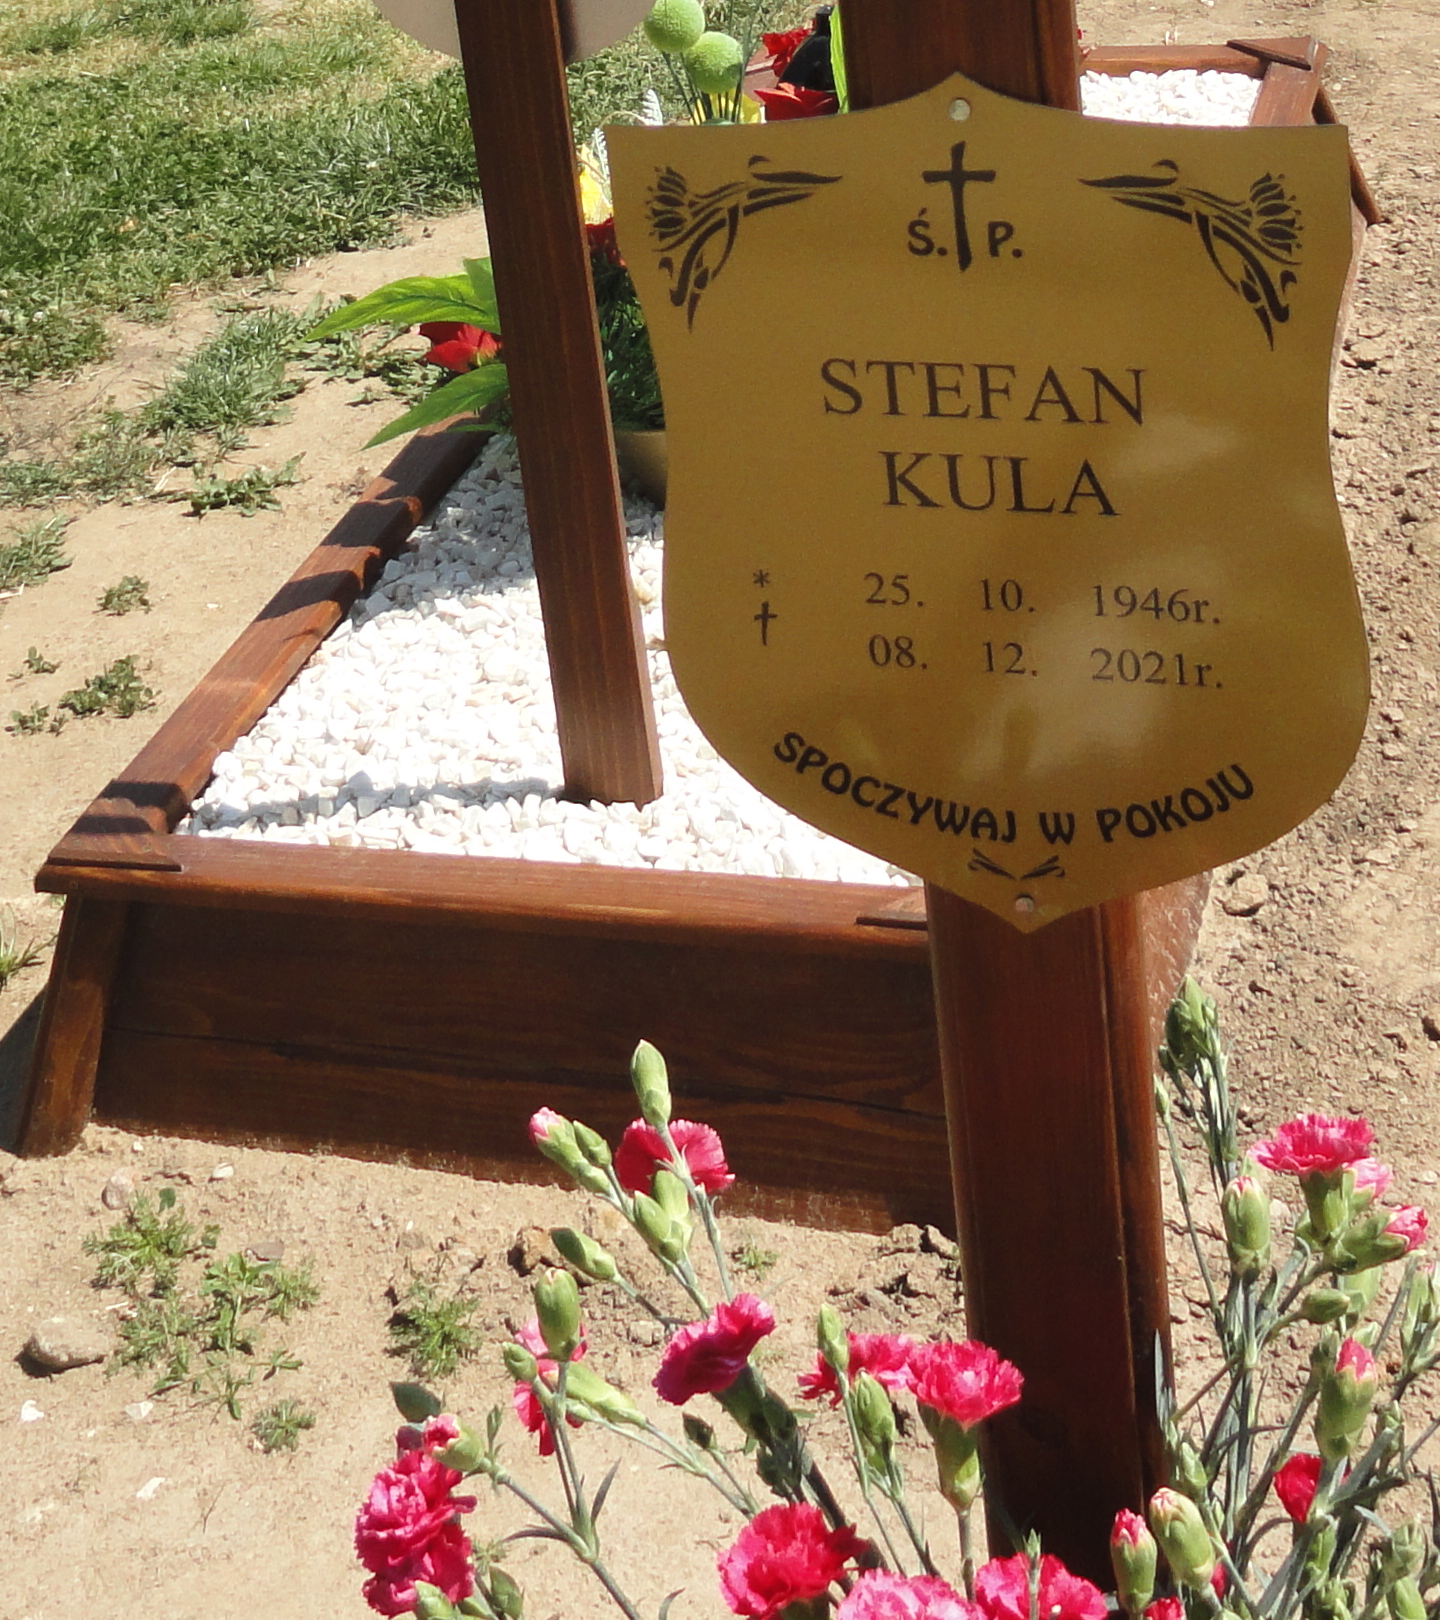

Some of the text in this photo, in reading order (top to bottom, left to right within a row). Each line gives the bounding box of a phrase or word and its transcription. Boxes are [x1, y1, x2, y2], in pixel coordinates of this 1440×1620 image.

[907, 207, 1023, 258] Ś. P.
[820, 357, 1147, 427] STEFAN
[878, 450, 1122, 516] KULA
[864, 572, 1222, 625] 25. 10. 1946r.
[868, 634, 1223, 689] 08. 12. 2021r.
[773, 732, 1256, 845] SPOCZYWAJ W POKOJU
